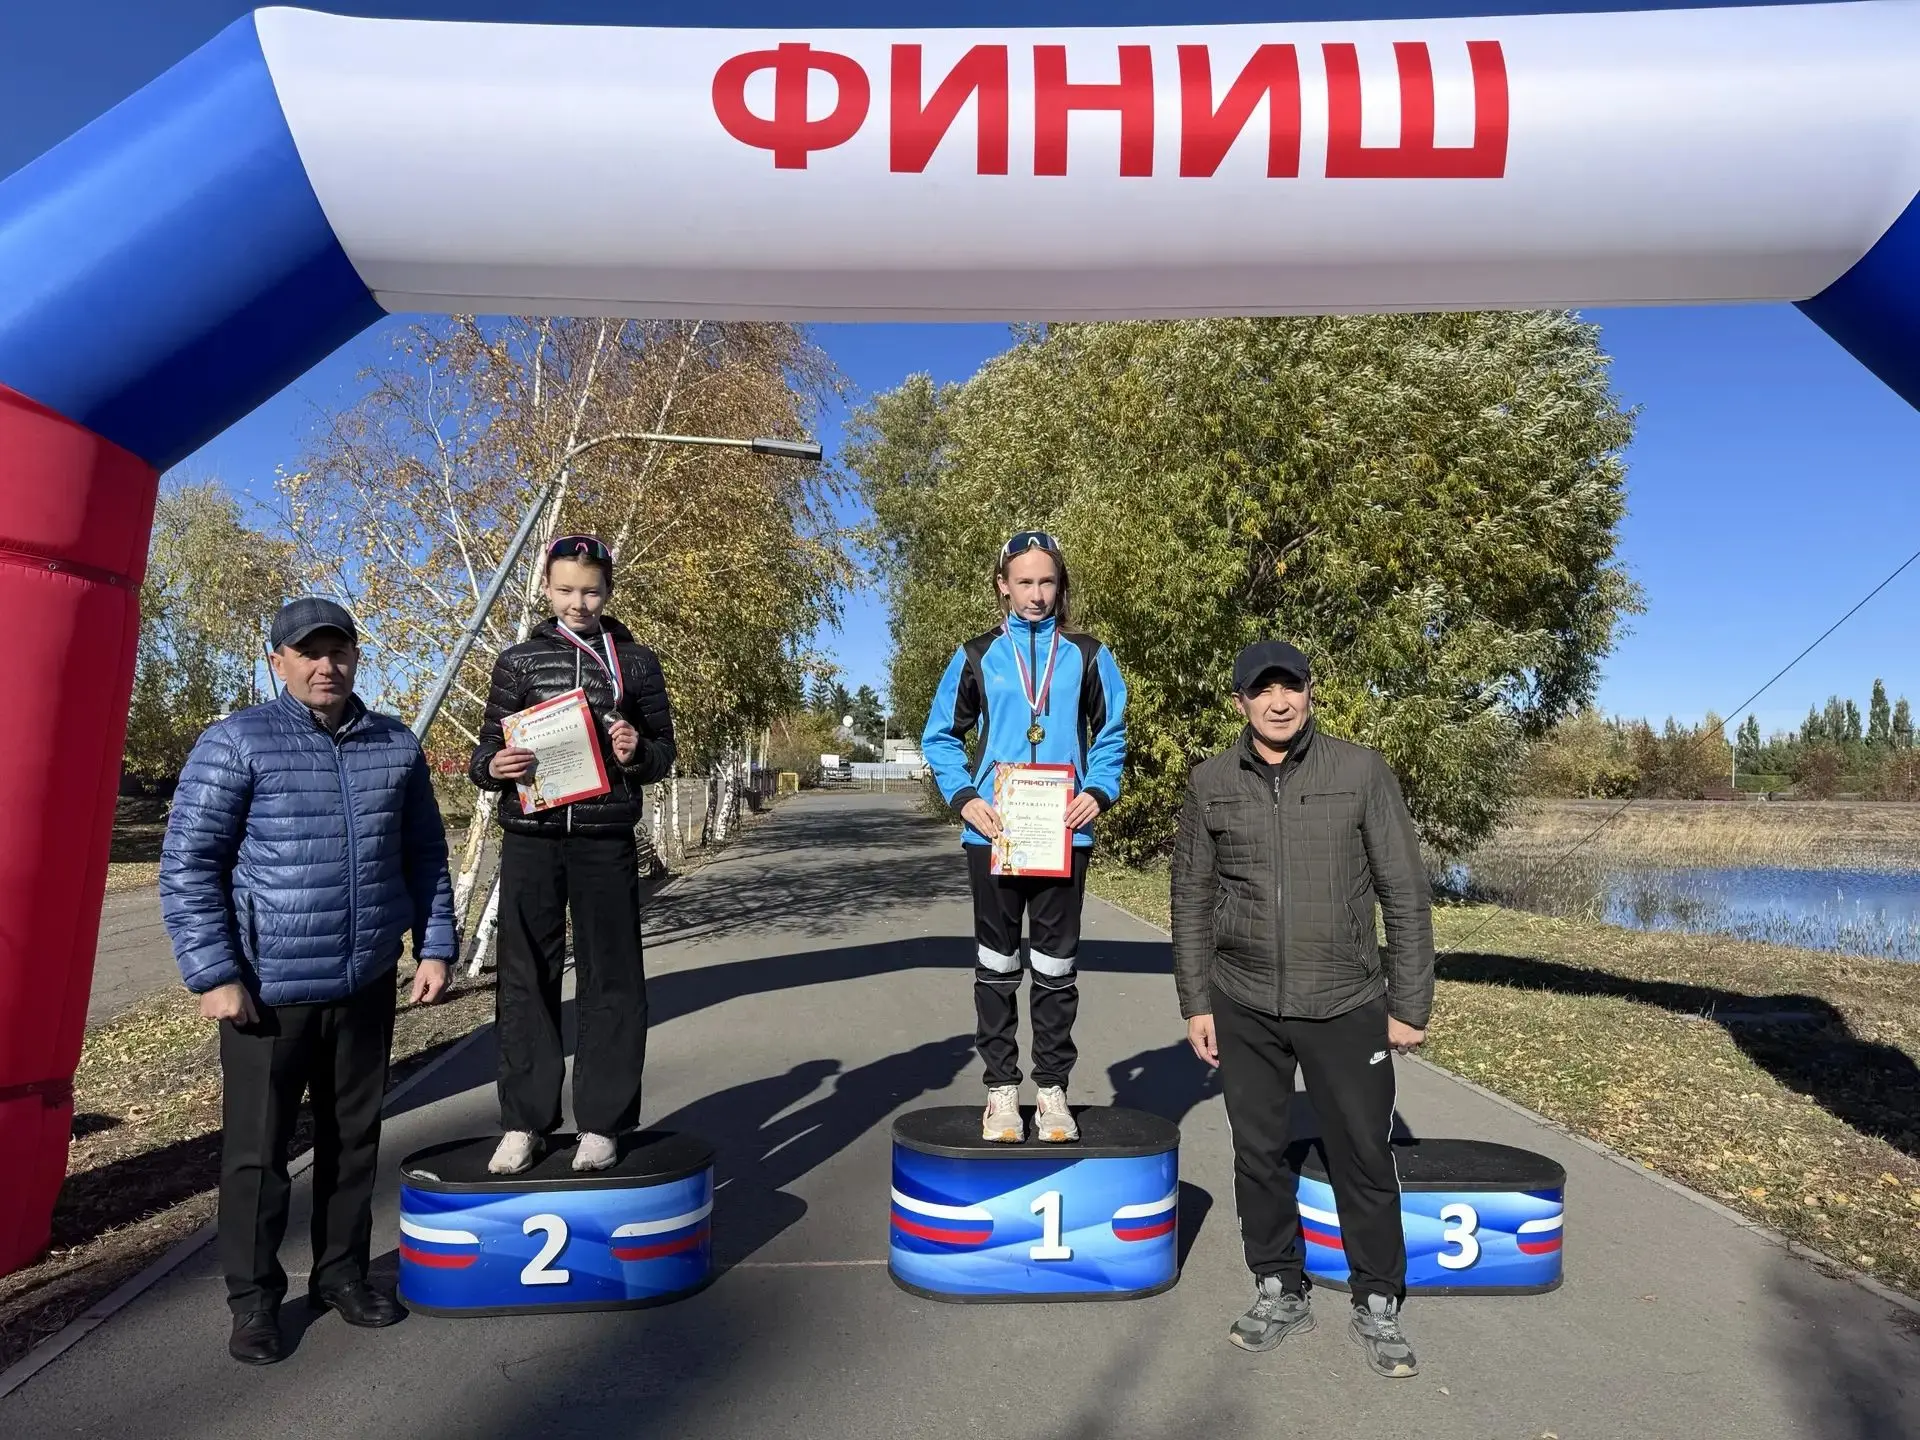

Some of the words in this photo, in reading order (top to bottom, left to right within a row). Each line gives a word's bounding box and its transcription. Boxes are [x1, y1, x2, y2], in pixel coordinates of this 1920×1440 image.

[712, 40, 1509, 179] ФИНИШ
[521, 707, 570, 728] ГРАМОТА
[1011, 779, 1058, 787] ГРАМОТА
[520, 1213, 570, 1285] 2
[1029, 1190, 1072, 1260] 1
[1437, 1202, 1480, 1269] 3
